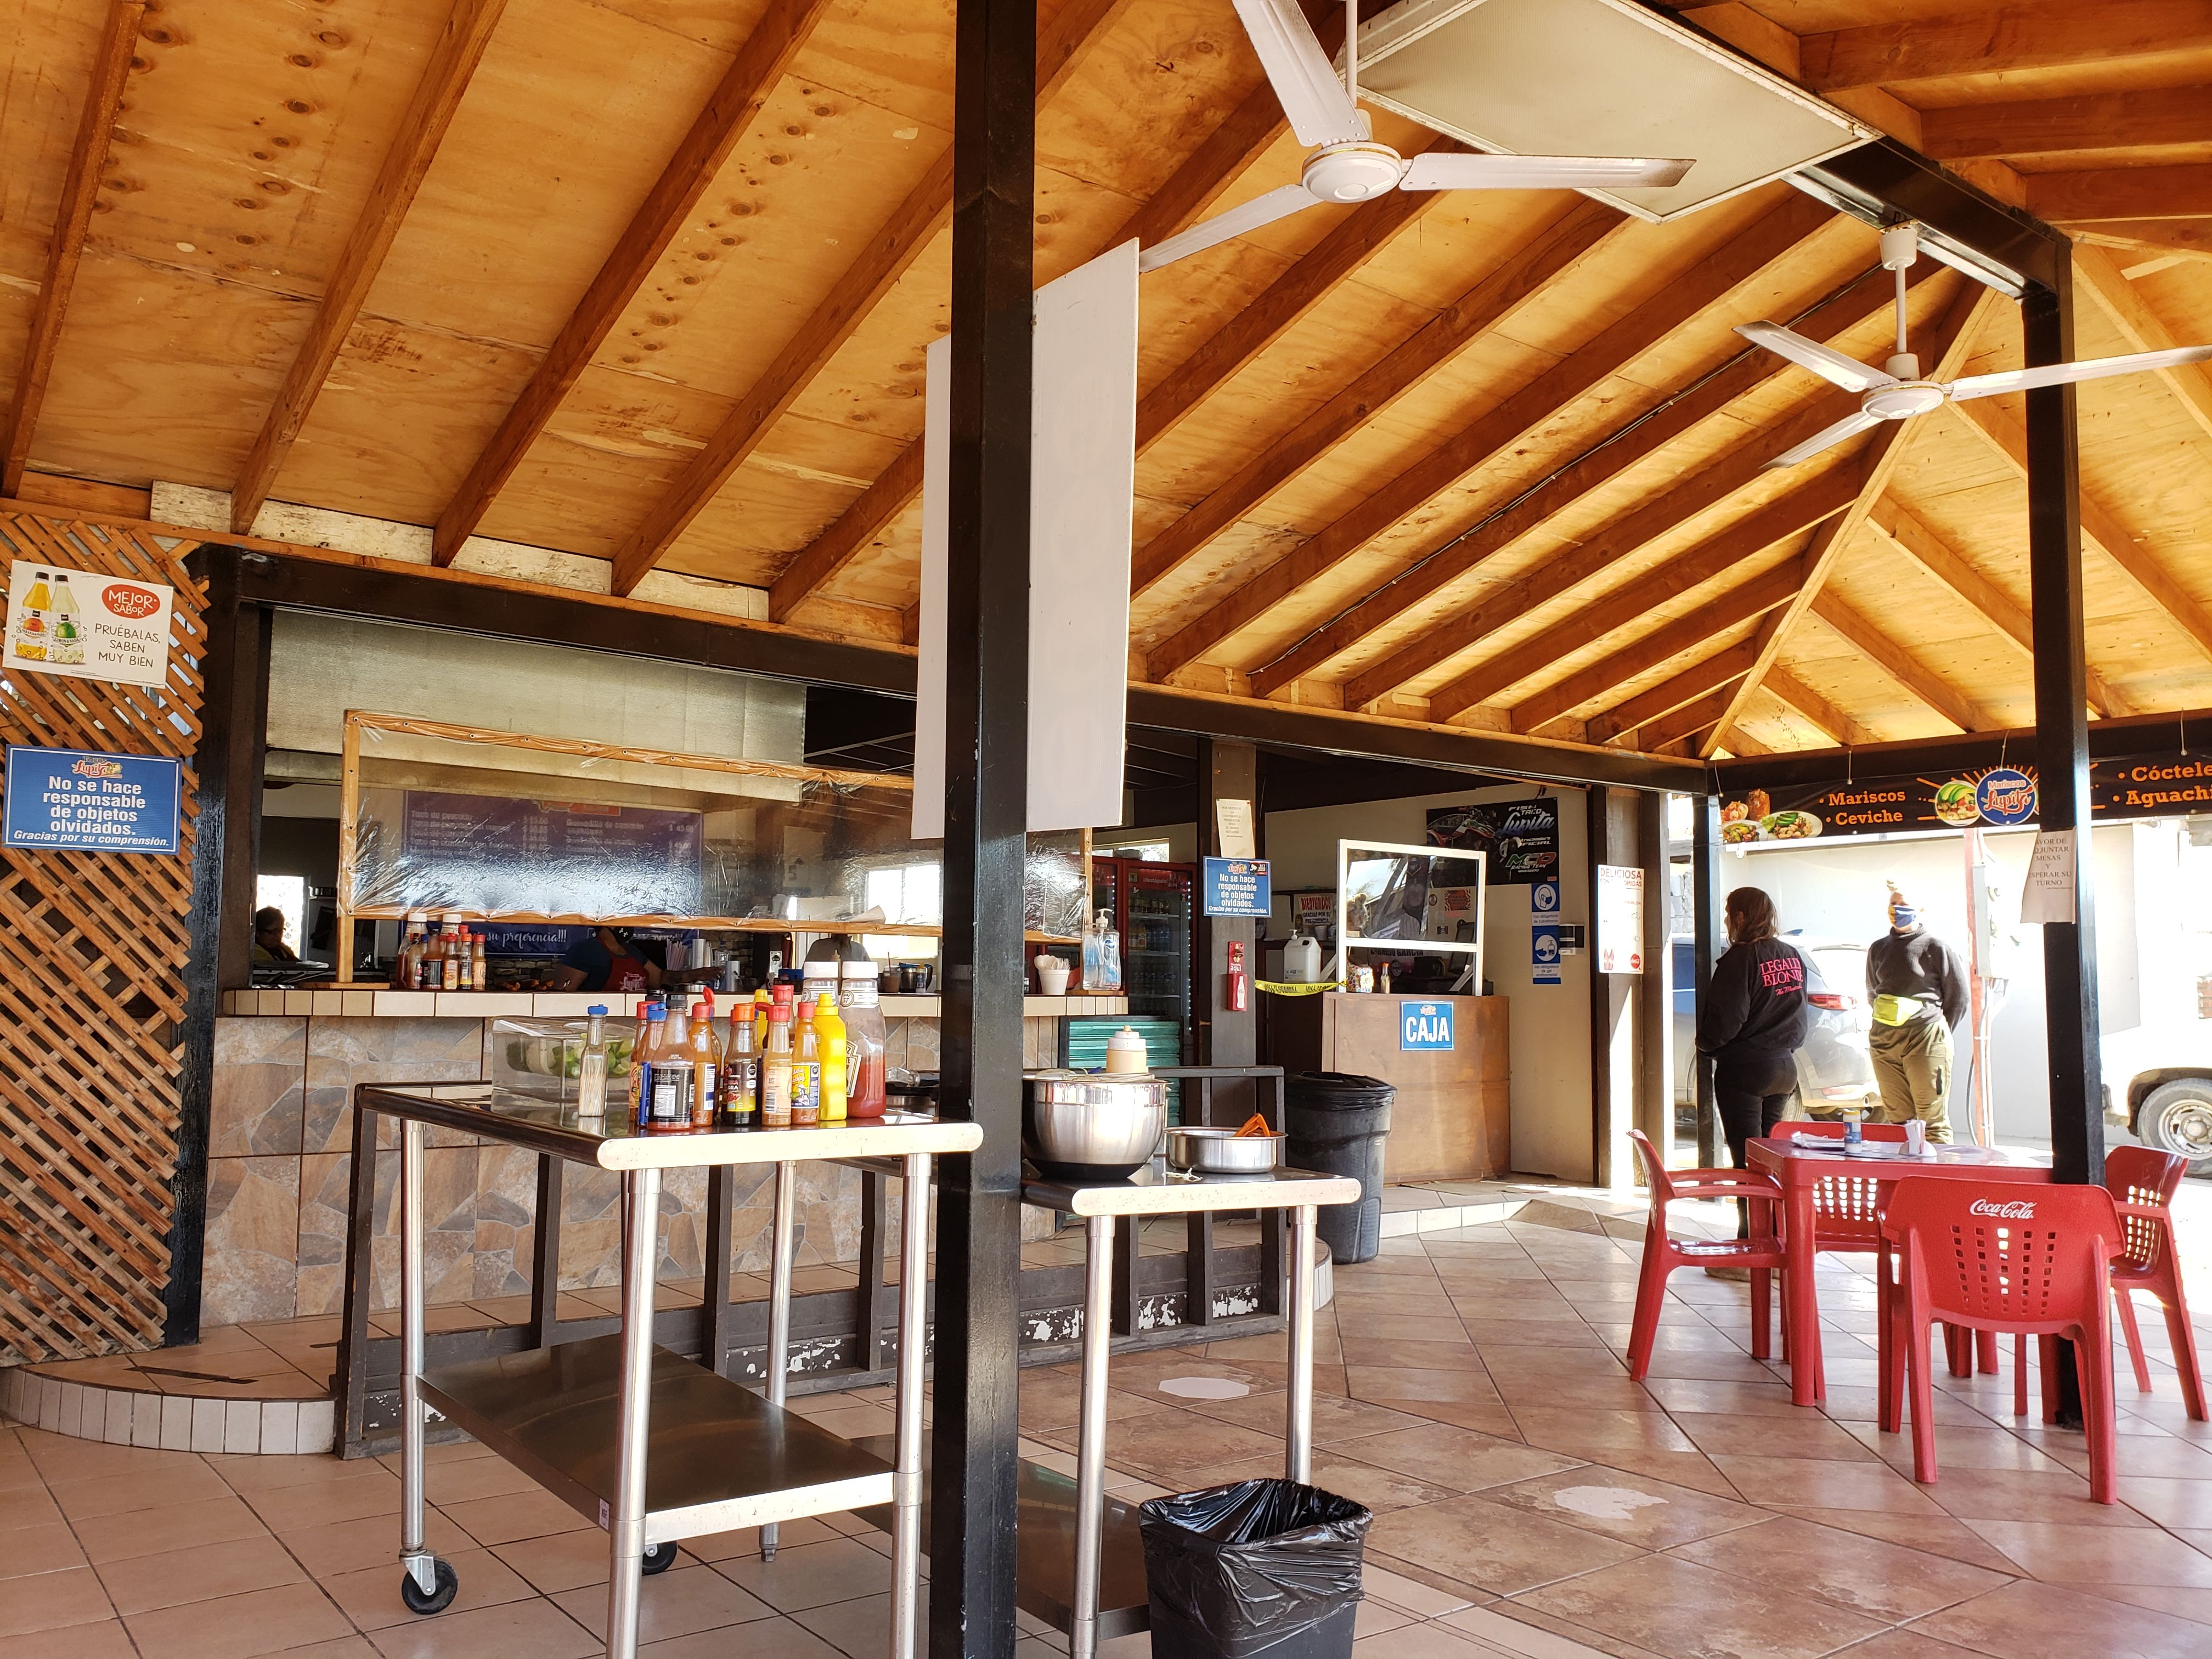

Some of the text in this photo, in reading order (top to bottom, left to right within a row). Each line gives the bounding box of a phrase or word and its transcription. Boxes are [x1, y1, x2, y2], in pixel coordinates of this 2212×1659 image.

[108, 589, 154, 610] MEJOR
[113, 603, 145, 617] SABOR
[94, 622, 161, 644] PRUÉBALAS,
[109, 639, 145, 653] SABEN
[98, 651, 154, 668] MUY BIEN
[72, 761, 111, 777] Lupita
[2131, 761, 2212, 782] Cóctele
[48, 776, 142, 795] No se hace
[1987, 779, 2026, 789] Mariscos
[43, 792, 146, 809] responsable
[1828, 790, 1906, 806] Mariscos
[1981, 786, 2034, 815] Lupita
[50, 804, 138, 822] de objetos
[1835, 809, 1903, 826] Ceviche
[50, 820, 137, 836] olvidados.
[1496, 811, 1555, 835] Lupita
[14, 830, 170, 847] Gracias por su comprensión.
[1505, 852, 1557, 867] MCO
[1220, 873, 1229, 882] No
[1239, 874, 1255, 883] hace
[1600, 867, 1642, 880] DELICIOSA
[1218, 883, 1257, 891] responsable
[1231, 891, 1254, 900] objetos
[1221, 899, 1254, 907] olvidados.
[486, 928, 567, 950] su preferencia!!!
[1406, 1016, 1450, 1042] CAJA
